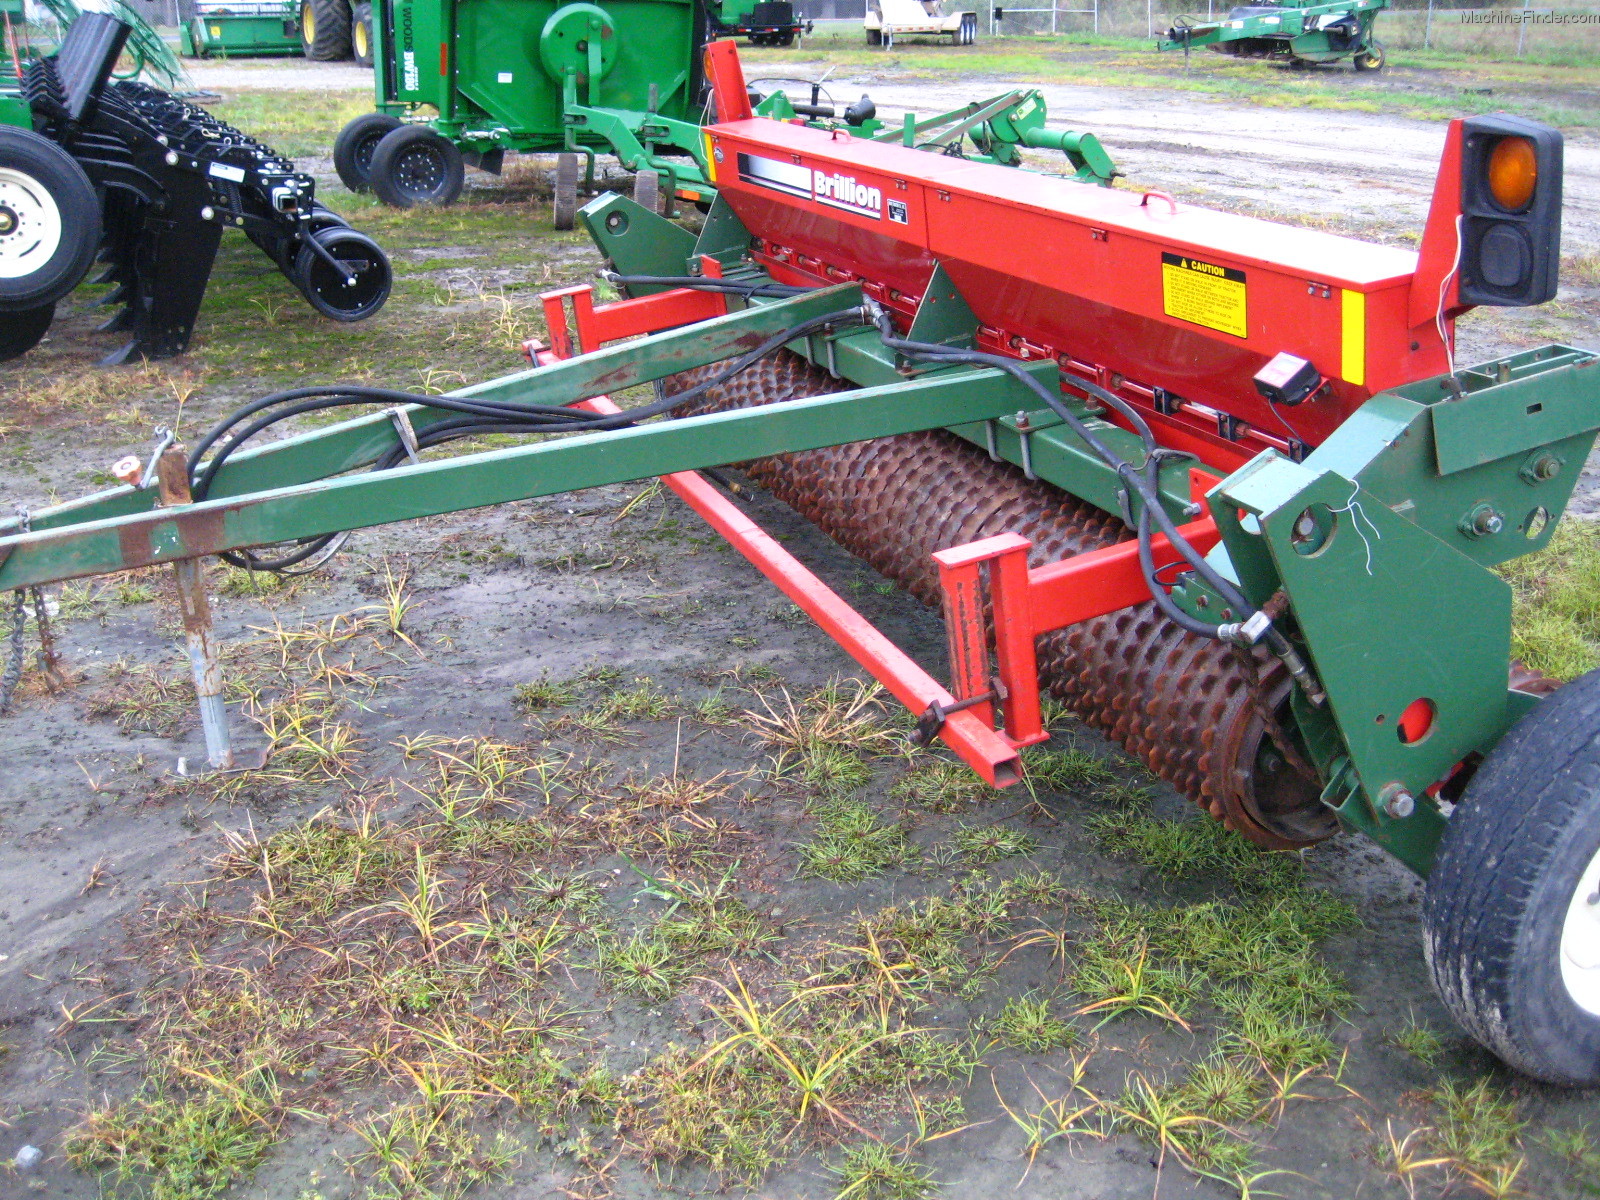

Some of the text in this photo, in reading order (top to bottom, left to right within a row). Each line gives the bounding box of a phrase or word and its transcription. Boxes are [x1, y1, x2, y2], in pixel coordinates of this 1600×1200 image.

[402, 7, 414, 52] WOODS
[814, 169, 881, 212] Brillion
[1191, 260, 1225, 277] CAUTION
